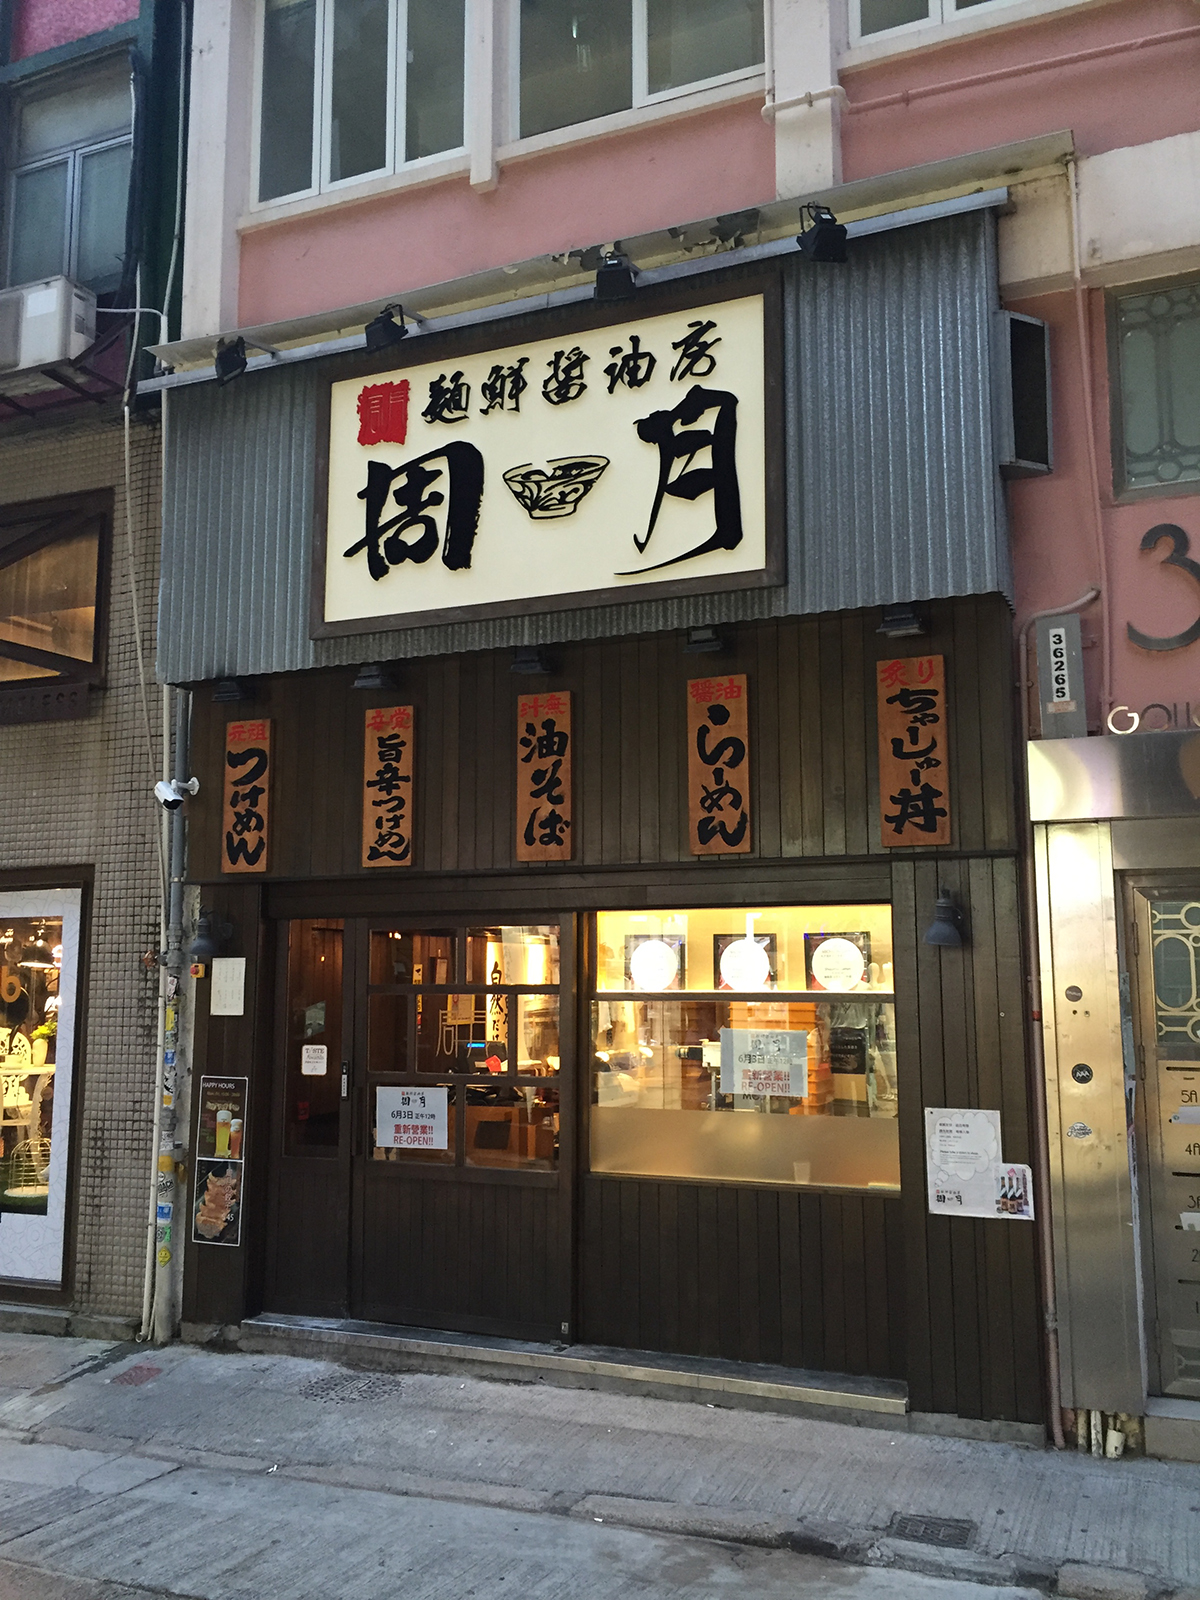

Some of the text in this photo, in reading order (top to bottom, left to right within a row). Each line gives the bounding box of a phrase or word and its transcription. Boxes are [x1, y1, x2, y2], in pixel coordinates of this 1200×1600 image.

[880, 659, 934, 688] 炙り
[1052, 634, 1066, 698] 36265
[519, 719, 570, 847] 油そば
[696, 704, 747, 847] らーめん
[884, 688, 947, 835] ちゃーしゅー丼
[226, 748, 268, 866] つけめん
[366, 733, 410, 861] 旨辛つけめん
[391, 1110, 413, 1120] 6月3日
[741, 1081, 790, 1093] RE-OPEN!!
[1181, 1090, 1198, 1103] 5A
[393, 1136, 434, 1146] RE-OPEN!!
